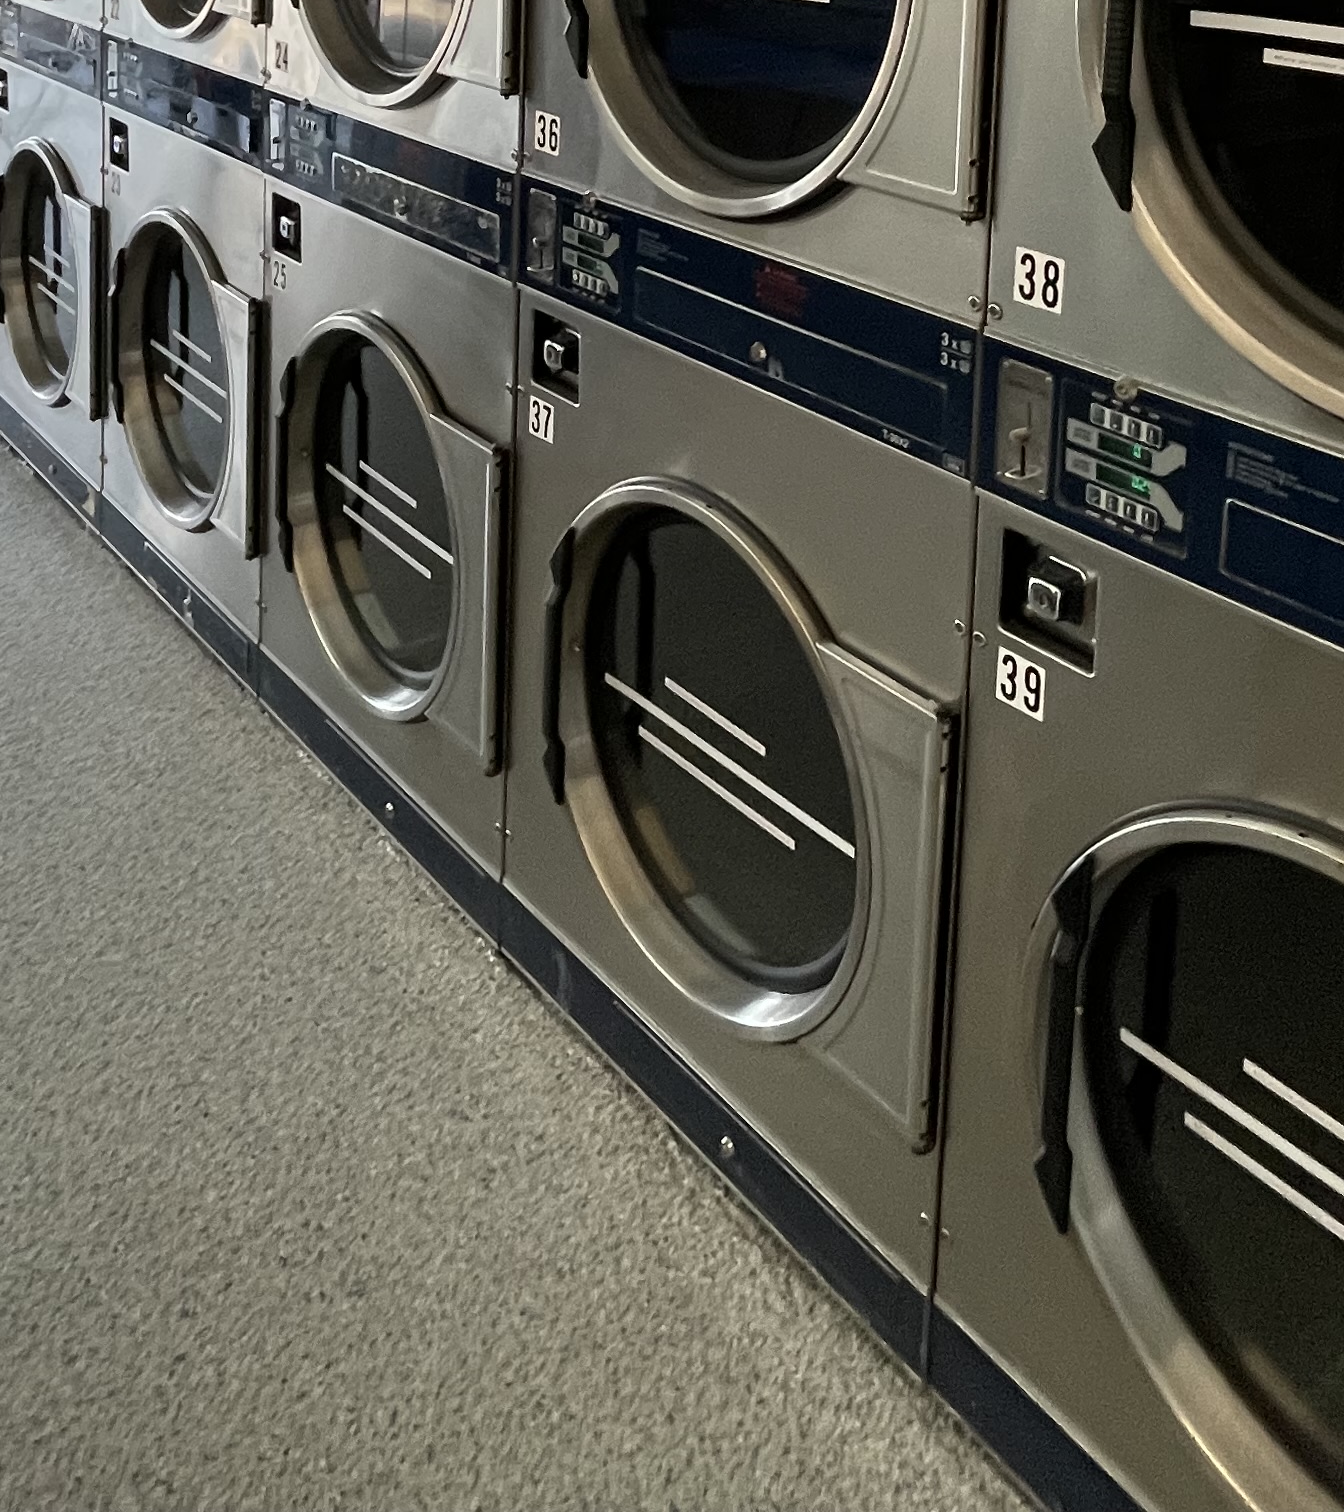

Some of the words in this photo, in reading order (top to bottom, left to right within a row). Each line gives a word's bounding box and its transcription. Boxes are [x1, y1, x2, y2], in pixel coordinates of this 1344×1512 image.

[274, 41, 289, 71] 24
[536, 113, 558, 153] 36
[273, 260, 288, 290] 25
[1018, 252, 1060, 309] 38
[940, 332, 949, 346] 3
[939, 351, 949, 366] 3
[531, 399, 553, 440] 37
[1000, 654, 1043, 714] 39
